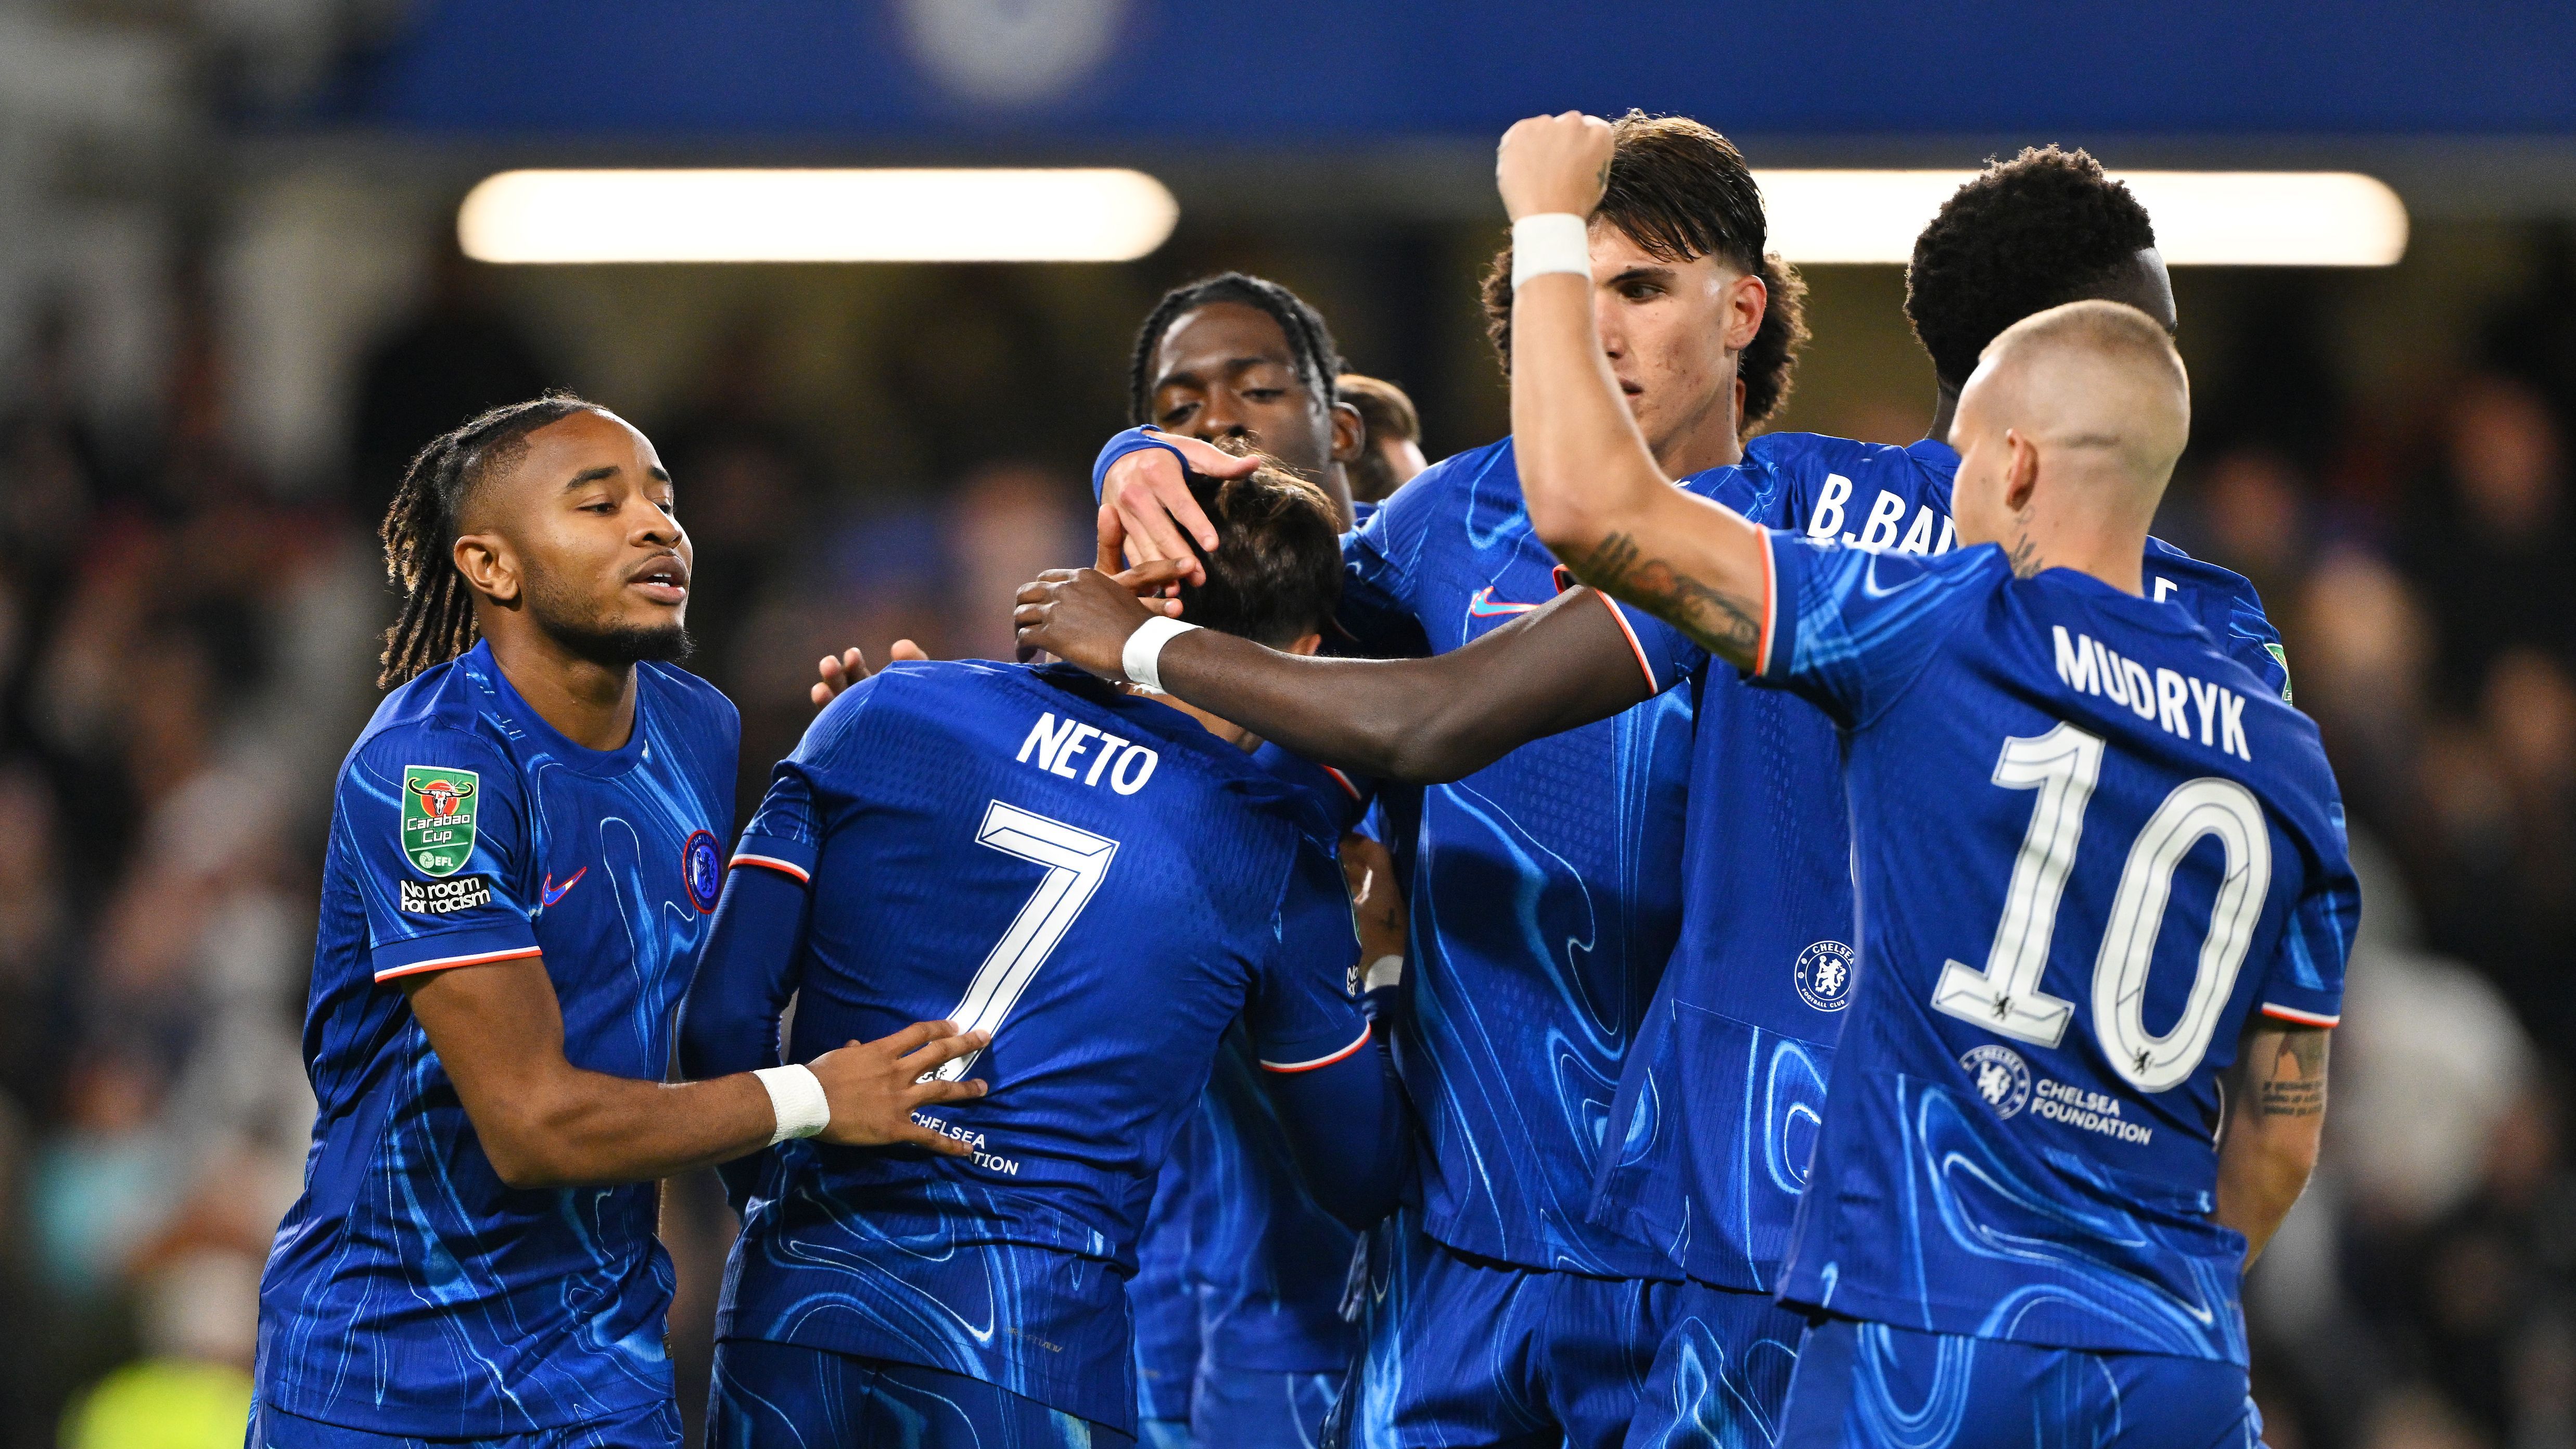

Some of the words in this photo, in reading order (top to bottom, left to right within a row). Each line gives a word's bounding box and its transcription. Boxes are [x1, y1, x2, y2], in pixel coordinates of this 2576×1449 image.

[2052, 625, 2251, 762] MUDRYK
[1016, 712, 1158, 795] NETO
[406, 814, 470, 831] Carabao
[423, 830, 452, 843] Cup
[435, 856, 453, 867] EFL
[401, 880, 425, 898] No
[427, 878, 480, 899] room
[401, 896, 427, 913] for
[430, 888, 491, 913] racism
[1930, 721, 2272, 1094] 10
[915, 799, 1120, 1083] 7
[1812, 943, 1854, 964] CHELSEA
[1802, 988, 1827, 1008] FOOTBALL
[1830, 999, 1845, 1008] CLUB
[2036, 1079, 2120, 1117] CHELSEA
[911, 1112, 985, 1149] CHELSEA
[2031, 1097, 2152, 1145] FOUNDATION
